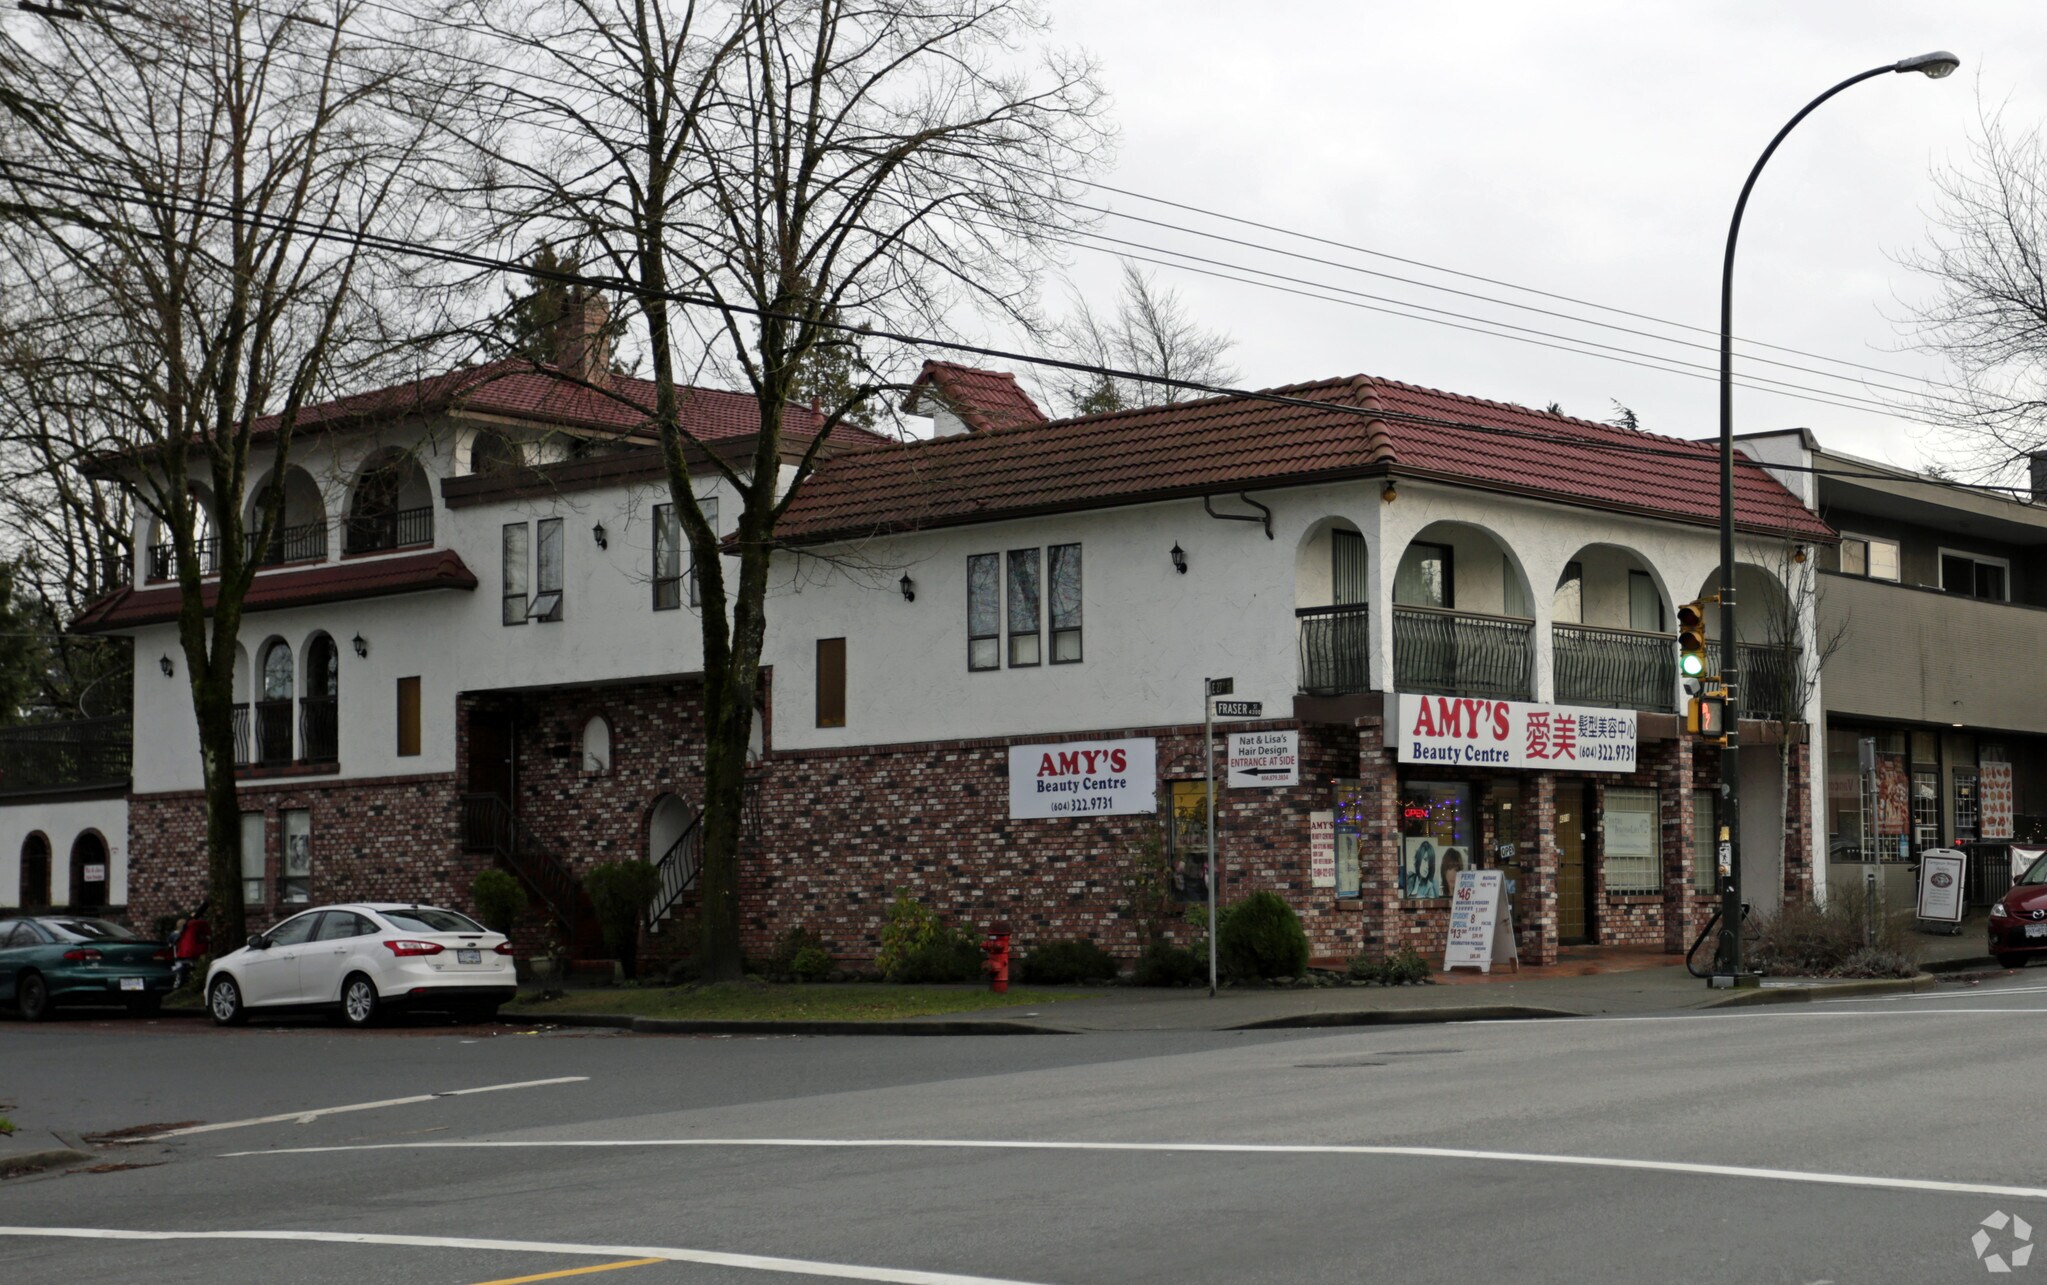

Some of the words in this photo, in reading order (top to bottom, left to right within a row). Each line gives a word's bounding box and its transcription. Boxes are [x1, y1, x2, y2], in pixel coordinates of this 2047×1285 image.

[1218, 703, 1248, 715] FRASER
[1413, 695, 1510, 741] AMY'S
[1526, 711, 1577, 760] 愛美
[1578, 714, 1637, 740] 髮型美容中心
[1240, 737, 1255, 745] Nat
[1256, 736, 1263, 744] &
[1264, 734, 1287, 744] Lisa's
[1239, 747, 1257, 756] Hair
[1258, 746, 1288, 756] Design
[1413, 742, 1461, 764] Beauty
[1465, 744, 1509, 762] Centre
[1579, 745, 1597, 759] (604)
[1598, 744, 1635, 762] 322.9731
[1036, 748, 1127, 777] AMY'S
[1231, 757, 1267, 767] ENTRANCE
[1269, 756, 1278, 765] AT
[1279, 756, 1295, 765] SIDE
[1037, 779, 1080, 793] Beauty
[1083, 776, 1127, 790] Centre
[1051, 801, 1070, 812] (604)
[1071, 796, 1113, 811] 322.9731
[1404, 808, 1428, 818] OPEN
